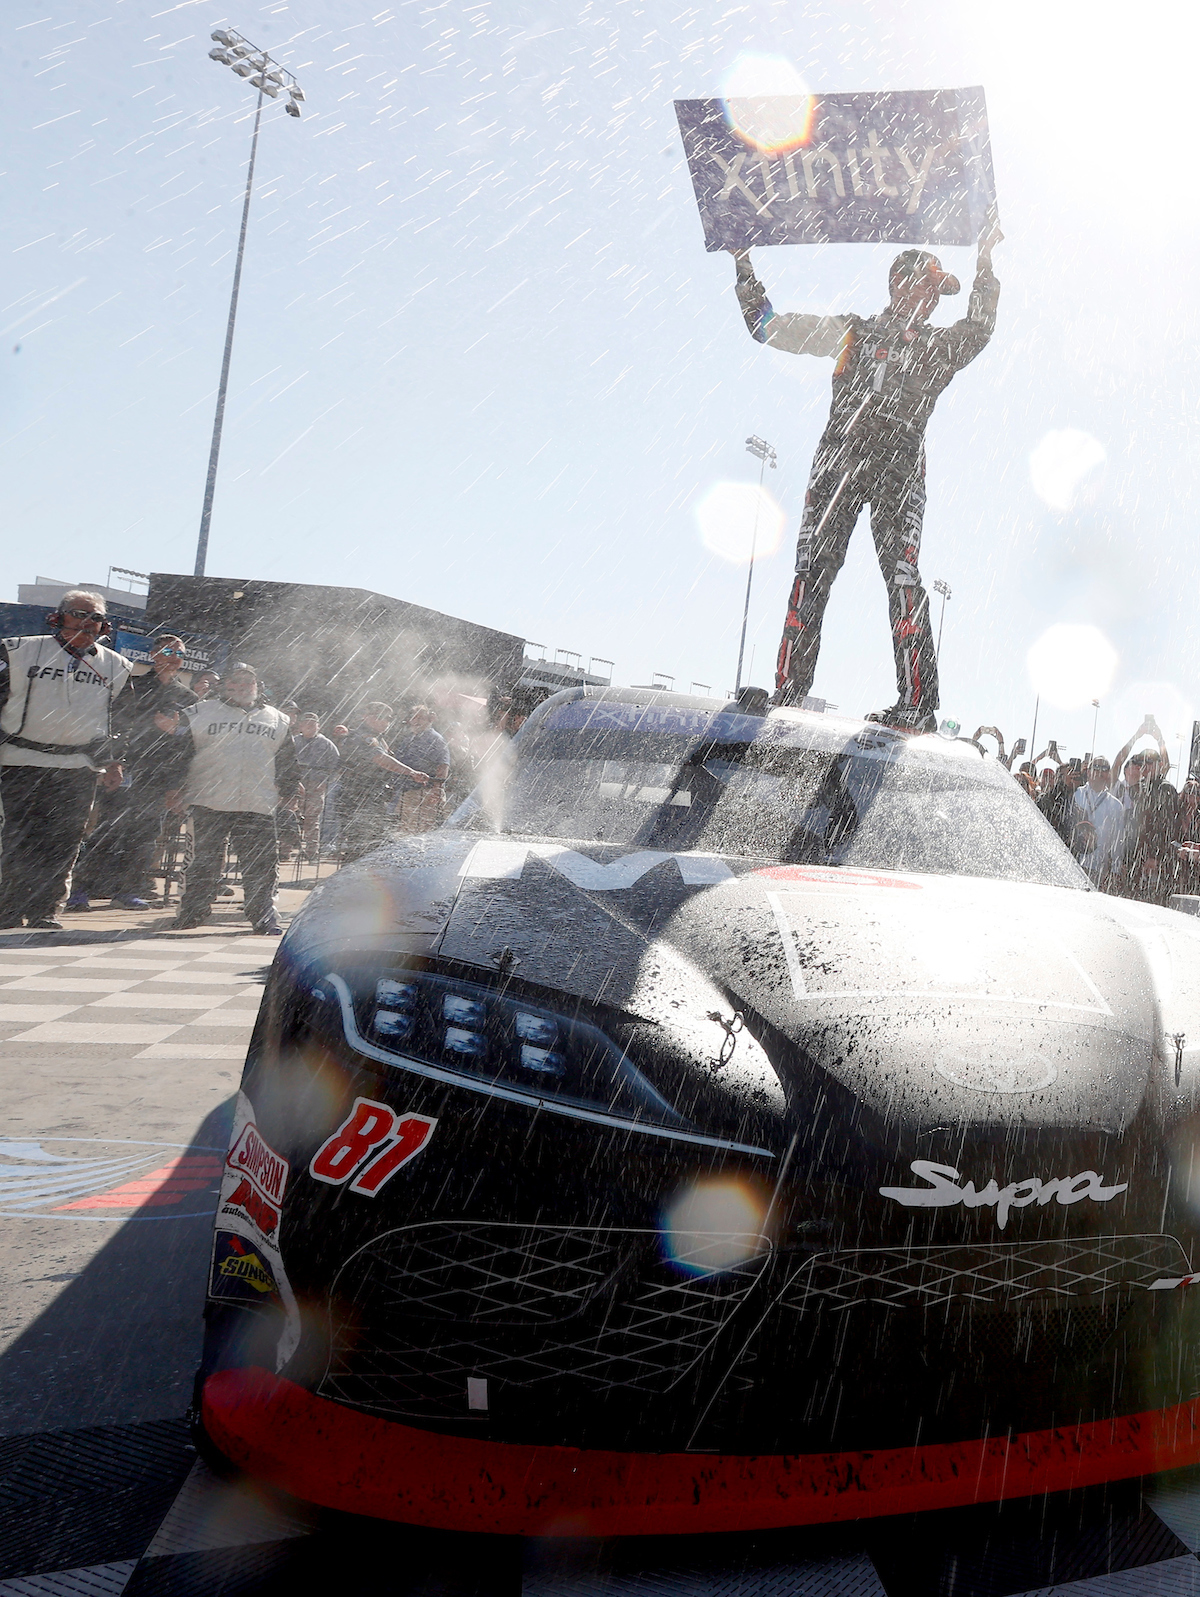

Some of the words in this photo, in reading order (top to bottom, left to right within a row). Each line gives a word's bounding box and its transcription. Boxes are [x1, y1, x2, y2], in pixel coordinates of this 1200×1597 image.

[710, 128, 934, 219] xfinity
[27, 666, 109, 689] FFCIAL
[208, 722, 276, 741] OFFICIAL
[238, 1131, 285, 1199] SIMPSON
[309, 1096, 438, 1198] 81
[879, 1159, 1128, 1230] Supra
